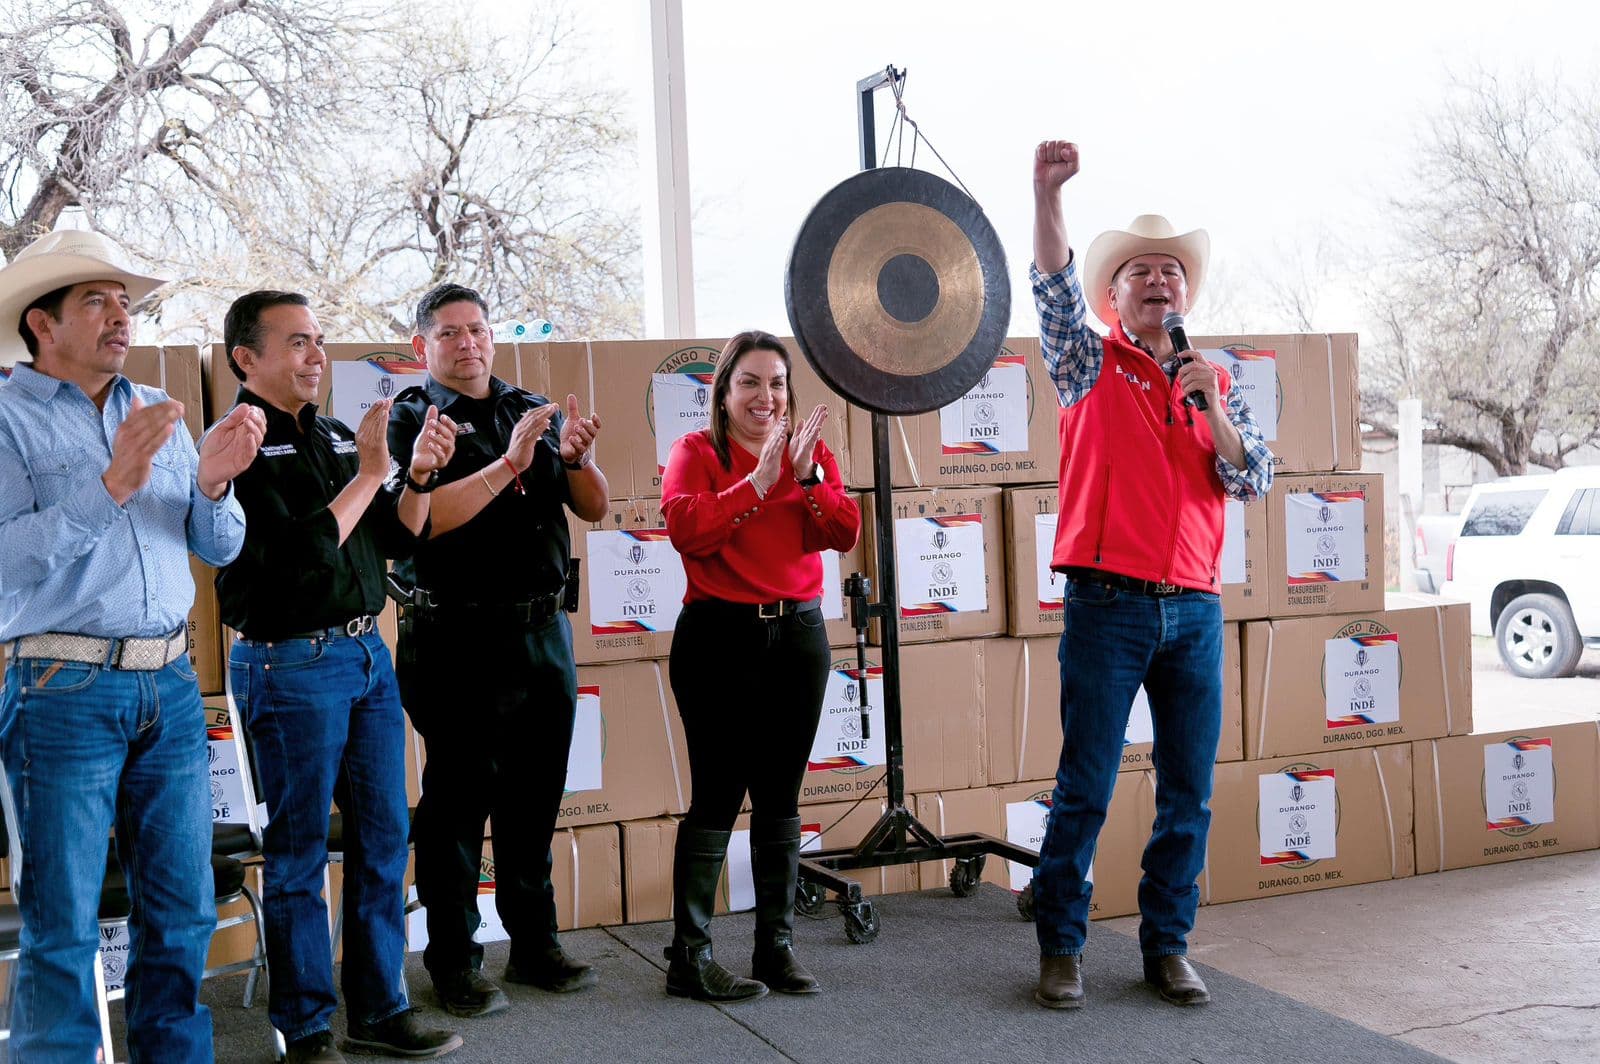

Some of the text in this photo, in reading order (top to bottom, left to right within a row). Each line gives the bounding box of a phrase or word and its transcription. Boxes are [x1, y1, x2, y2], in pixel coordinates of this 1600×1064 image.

[940, 461, 1038, 475] DURANGO, DGO. MEX.
[920, 552, 962, 561] DURANGO
[614, 568, 661, 576] DURANGO
[900, 620, 943, 632] STAINLESS STEEL
[595, 636, 645, 650] STAINLESS STEEL
[1344, 669, 1379, 677] DURANGO
[829, 705, 873, 714] DURANO
[1323, 726, 1406, 744] DURANGO, DGO. MEX.
[1502, 772, 1535, 781] DURANGO
[803, 782, 854, 797] DURANGO,
[558, 803, 612, 818] DGO. MEX.
[1279, 804, 1316, 813] DURANGO
[1484, 842, 1522, 856] DURANGO,
[1542, 838, 1560, 847] MEX.
[1258, 870, 1344, 889] DURANGO, DGO. MEX.
